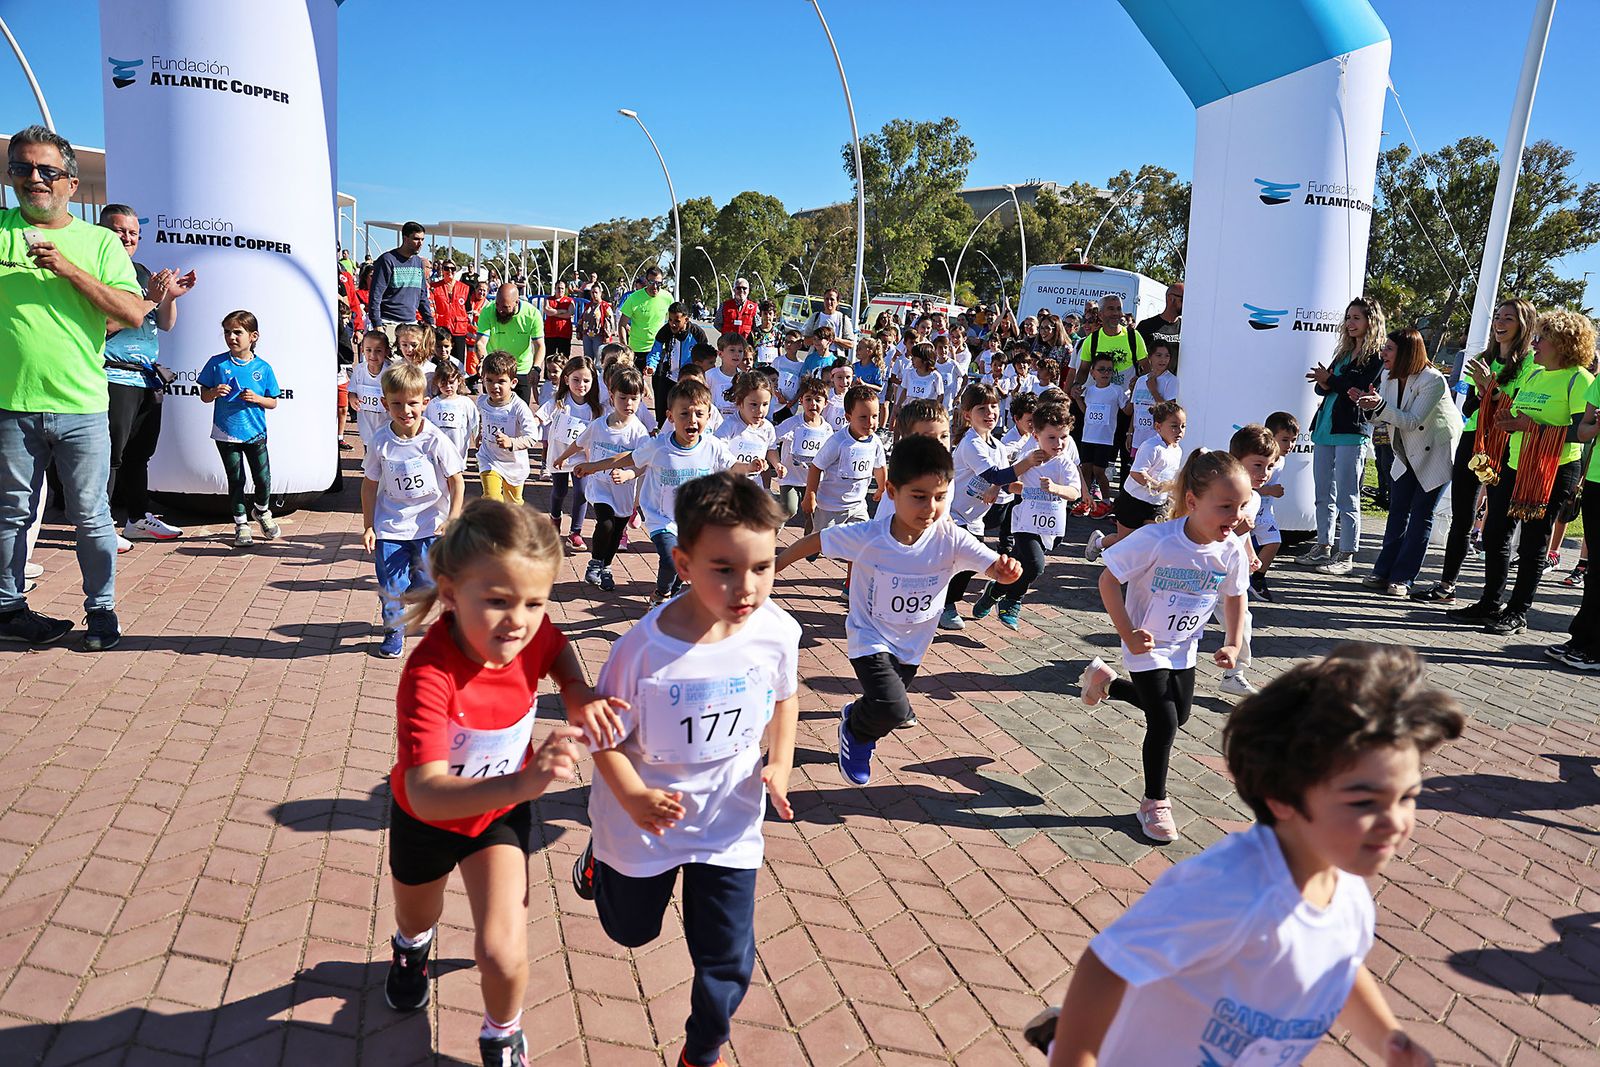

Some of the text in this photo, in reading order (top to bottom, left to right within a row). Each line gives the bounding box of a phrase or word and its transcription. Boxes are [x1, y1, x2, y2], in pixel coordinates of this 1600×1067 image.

[151, 55, 230, 76] Fundación
[150, 72, 289, 104] ATLANTIC COPPER
[1304, 194, 1355, 209] ATLANTIC
[157, 214, 233, 232] Fundación
[156, 230, 291, 254] ATLANTIC COPPER
[1038, 286, 1065, 294] BANCO
[1067, 287, 1077, 295] DE
[1056, 297, 1067, 305] DE
[1292, 320, 1338, 332] ATLANTI
[163, 384, 200, 396] ATLA
[363, 395, 379, 406] 018
[438, 412, 455, 422] 123
[1089, 412, 1104, 421] 033
[1139, 418, 1152, 427] 035
[802, 440, 820, 450] 094
[852, 461, 870, 472] 160
[395, 474, 424, 491] 125
[1032, 514, 1056, 528] 106
[891, 594, 932, 614] 093
[1167, 614, 1200, 632] 169
[680, 707, 742, 744] 177
